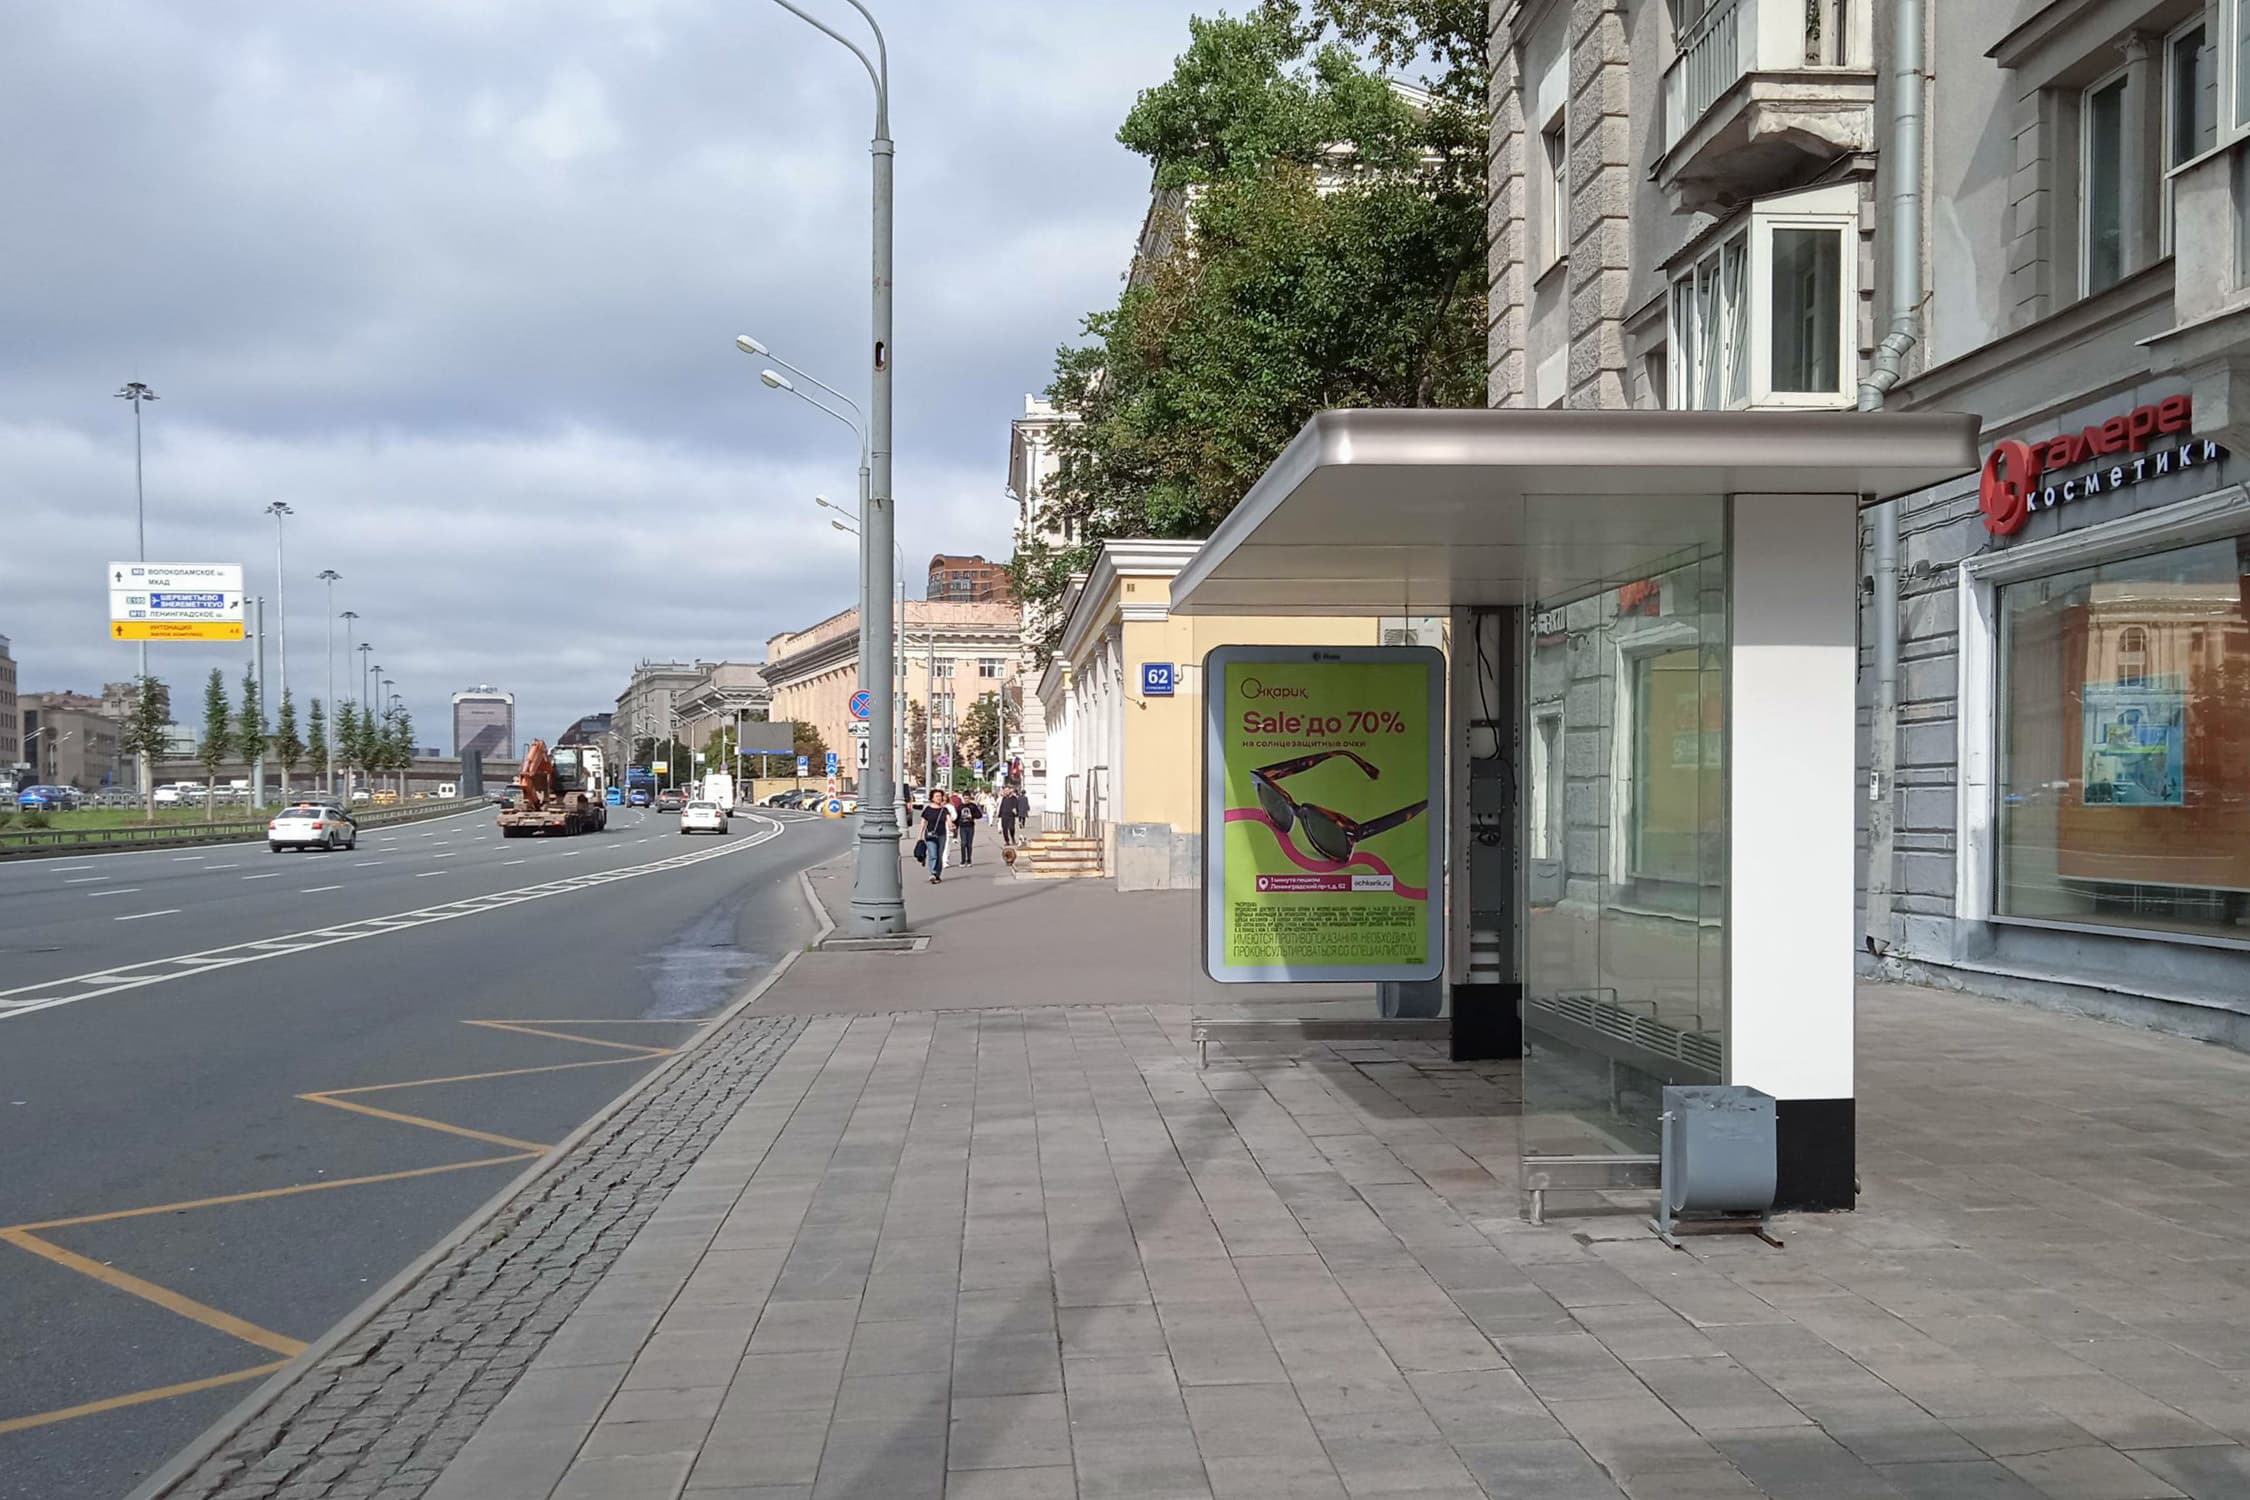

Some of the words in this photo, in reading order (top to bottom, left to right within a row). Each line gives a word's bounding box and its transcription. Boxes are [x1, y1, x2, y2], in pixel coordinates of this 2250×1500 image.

[2028, 394, 2192, 477] галере
[2027, 440, 2216, 513] косметики
[1148, 669, 1168, 684] 62
[1306, 716, 1342, 736] до
[1347, 711, 1405, 734] 70%
[1233, 932, 1274, 945] ИМЕЮТСЯ
[1361, 931, 1416, 944] НЕОБХОДИМО
[1233, 944, 1337, 957] ПРОКОНСУЛЬТИРОВАТЬСЯ
[1350, 944, 1416, 957] СПЕЦИАЛИСТОМ
